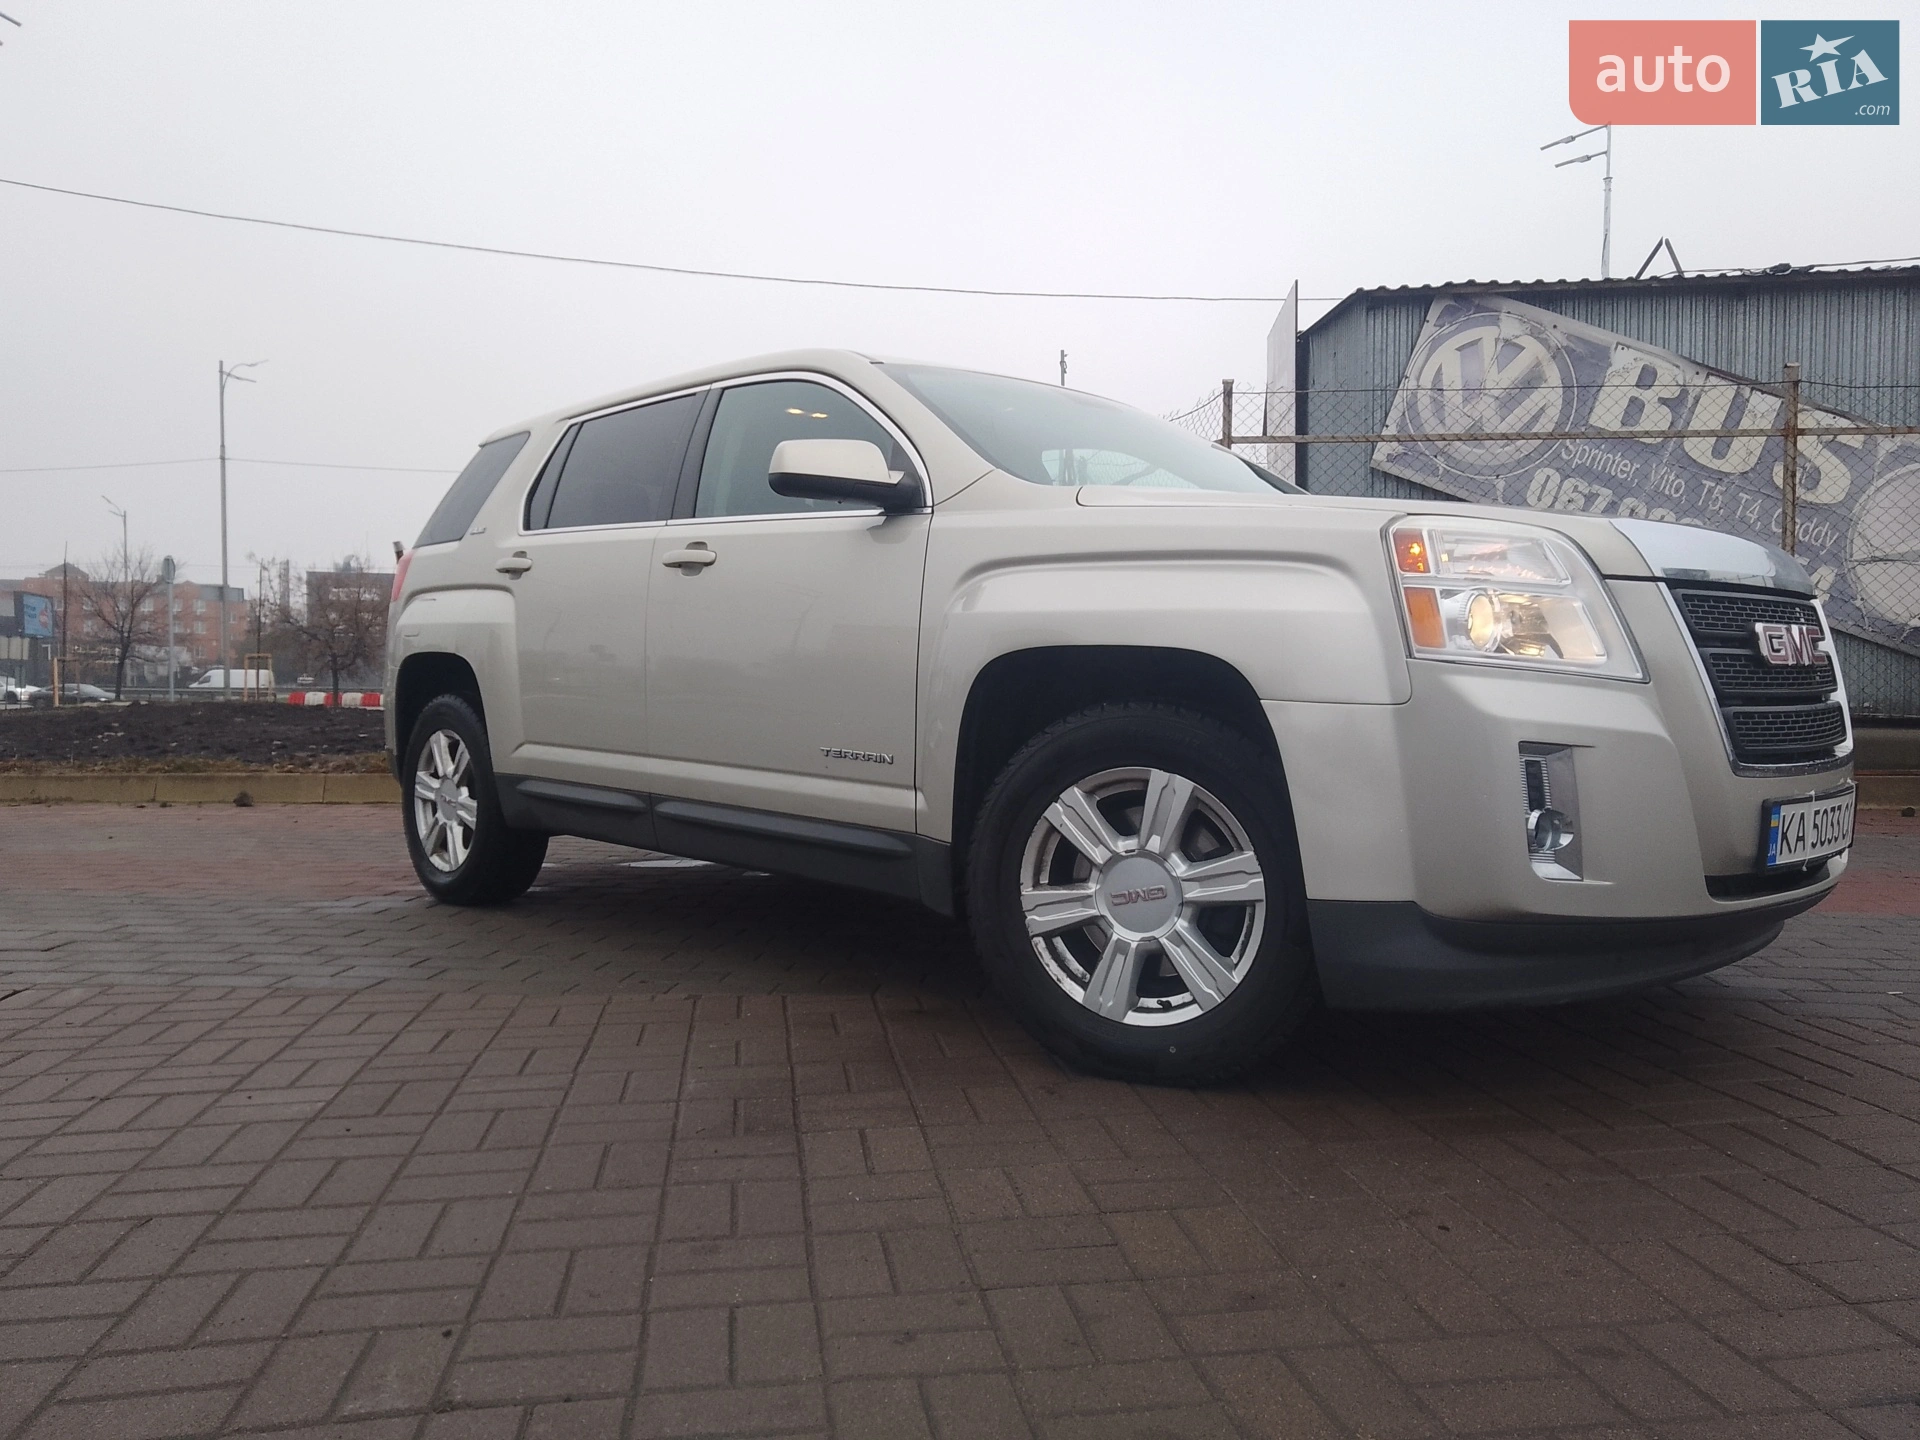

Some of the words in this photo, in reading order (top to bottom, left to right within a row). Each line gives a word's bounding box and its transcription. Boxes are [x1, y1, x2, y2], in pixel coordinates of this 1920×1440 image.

[1589, 342, 1866, 504] BUS
[1562, 438, 1640, 487] Sprinter,
[1651, 463, 1686, 503] Vito,
[1736, 492, 1763, 530] T4,
[1771, 508, 1839, 555] Cddy
[1755, 622, 1829, 666] GMC
[820, 746, 894, 765] TERRAIN
[1811, 804, 1842, 849] 5033
[1111, 885, 1167, 907] GMC
